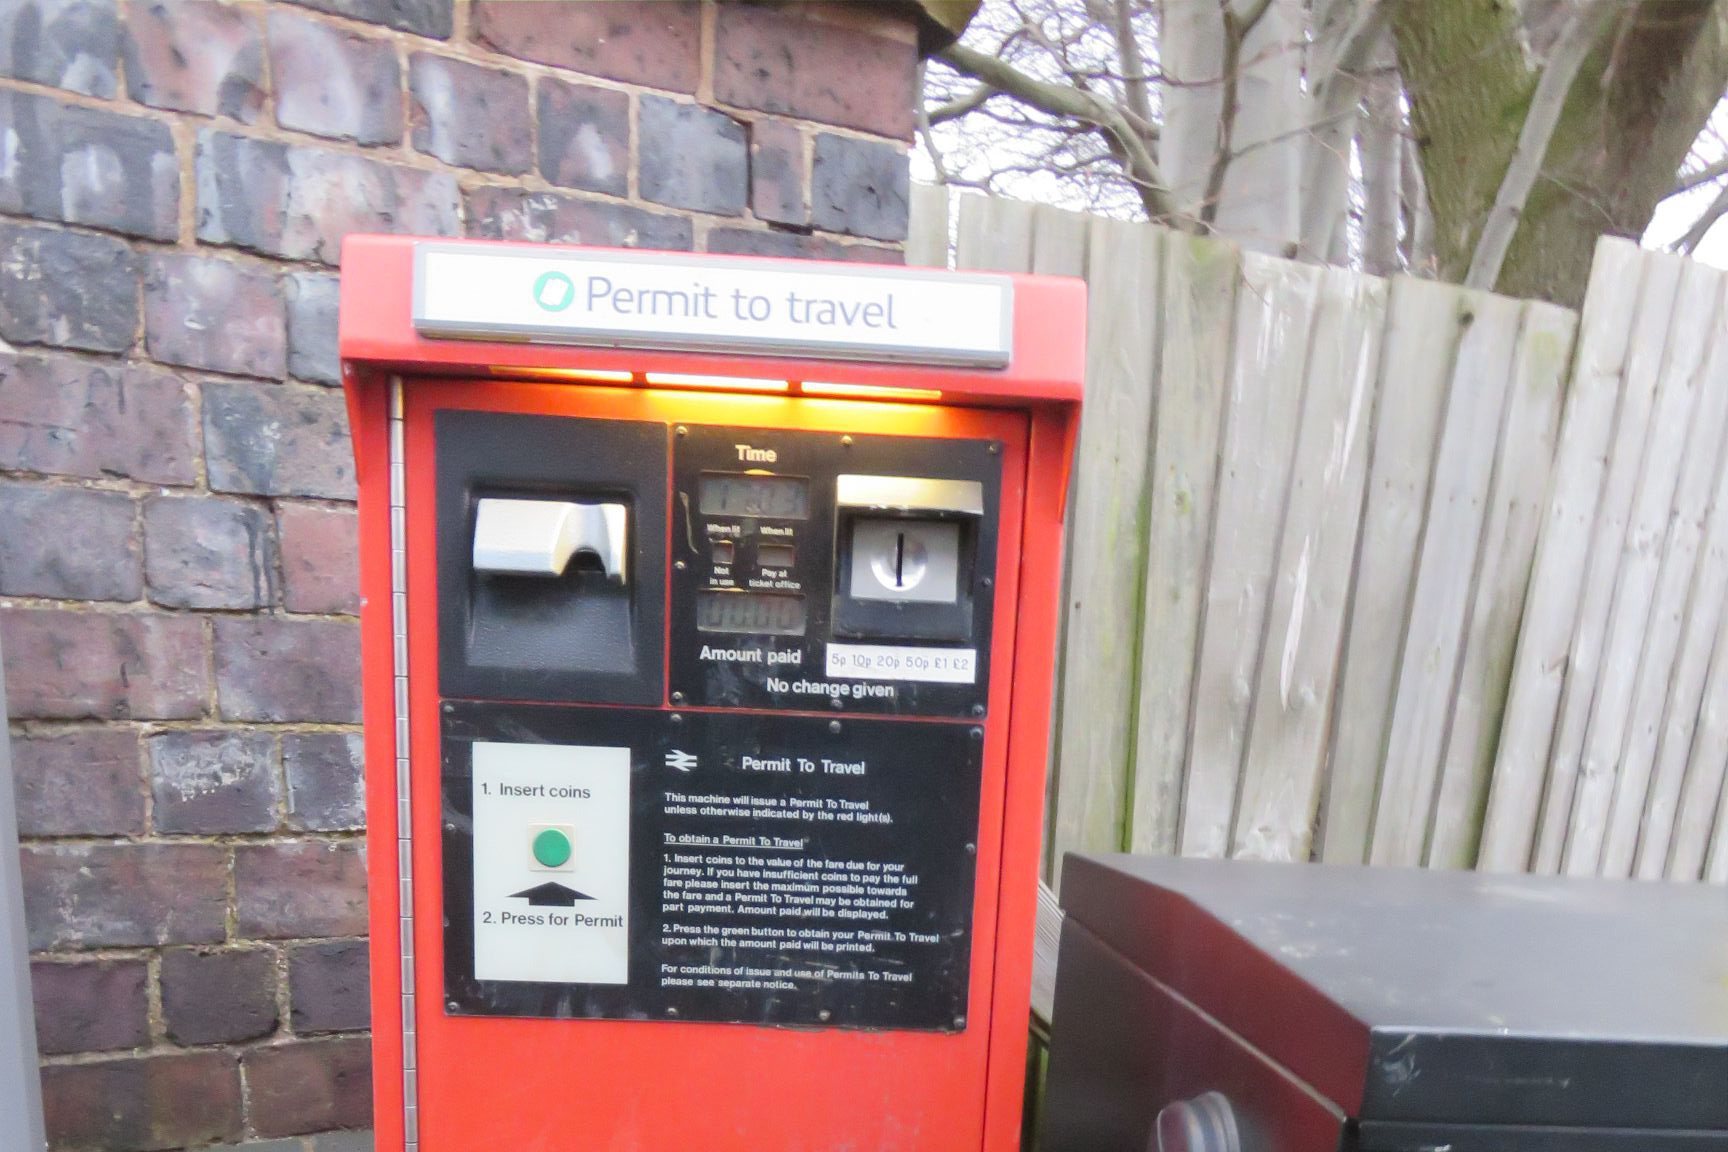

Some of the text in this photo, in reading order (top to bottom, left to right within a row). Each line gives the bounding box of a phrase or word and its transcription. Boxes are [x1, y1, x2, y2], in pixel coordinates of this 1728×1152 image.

[587, 276, 898, 329] Permit to travel
[735, 444, 777, 462] Time
[714, 566, 729, 576] Not
[762, 568, 788, 578] Pay at
[719, 578, 734, 586] use
[749, 579, 801, 590] ticket office
[700, 645, 802, 665] Amount paid
[832, 654, 968, 671] 5p 10p 20p 50p £1 £2
[766, 678, 894, 698] No change given
[742, 756, 865, 775] Permit To Travel
[482, 782, 591, 799] 1. Insert coins
[665, 792, 868, 810] This machine will issue a Permit To Travel
[664, 805, 893, 824] unless otherwise indicated by the red light(s).
[664, 832, 804, 848] To obtain a Permit To Travel
[664, 854, 904, 872] 1. Insert coins to the value of the fare due for your
[664, 866, 918, 885] journey. If you have insufficient coins to pay the full
[664, 878, 908, 896] fare please insert the maximum possible towards
[663, 890, 680, 900] the
[682, 891, 702, 900] fare
[705, 892, 724, 901] and
[735, 892, 768, 903] Permit
[770, 894, 782, 903] To
[784, 894, 814, 905] Travel
[816, 898, 836, 907] may
[839, 896, 851, 906] be
[853, 898, 897, 908] obtained
[900, 899, 914, 909] for
[482, 911, 624, 928] 2. Press for Permit
[662, 902, 888, 920] part payment. Amount paid will be displayed.
[662, 924, 940, 943] 2. Press the green button to obtain your Permit To Travel
[662, 937, 876, 953] upon which the amount paid will be printed.
[662, 964, 678, 974] For
[680, 965, 732, 976] conditions
[734, 966, 744, 976] of
[746, 967, 772, 976] issue
[774, 968, 792, 978] and
[794, 970, 811, 978] use
[814, 969, 825, 978] of
[868, 971, 880, 981] To
[882, 972, 912, 982] Travel
[662, 978, 798, 991] please see separate notice.
